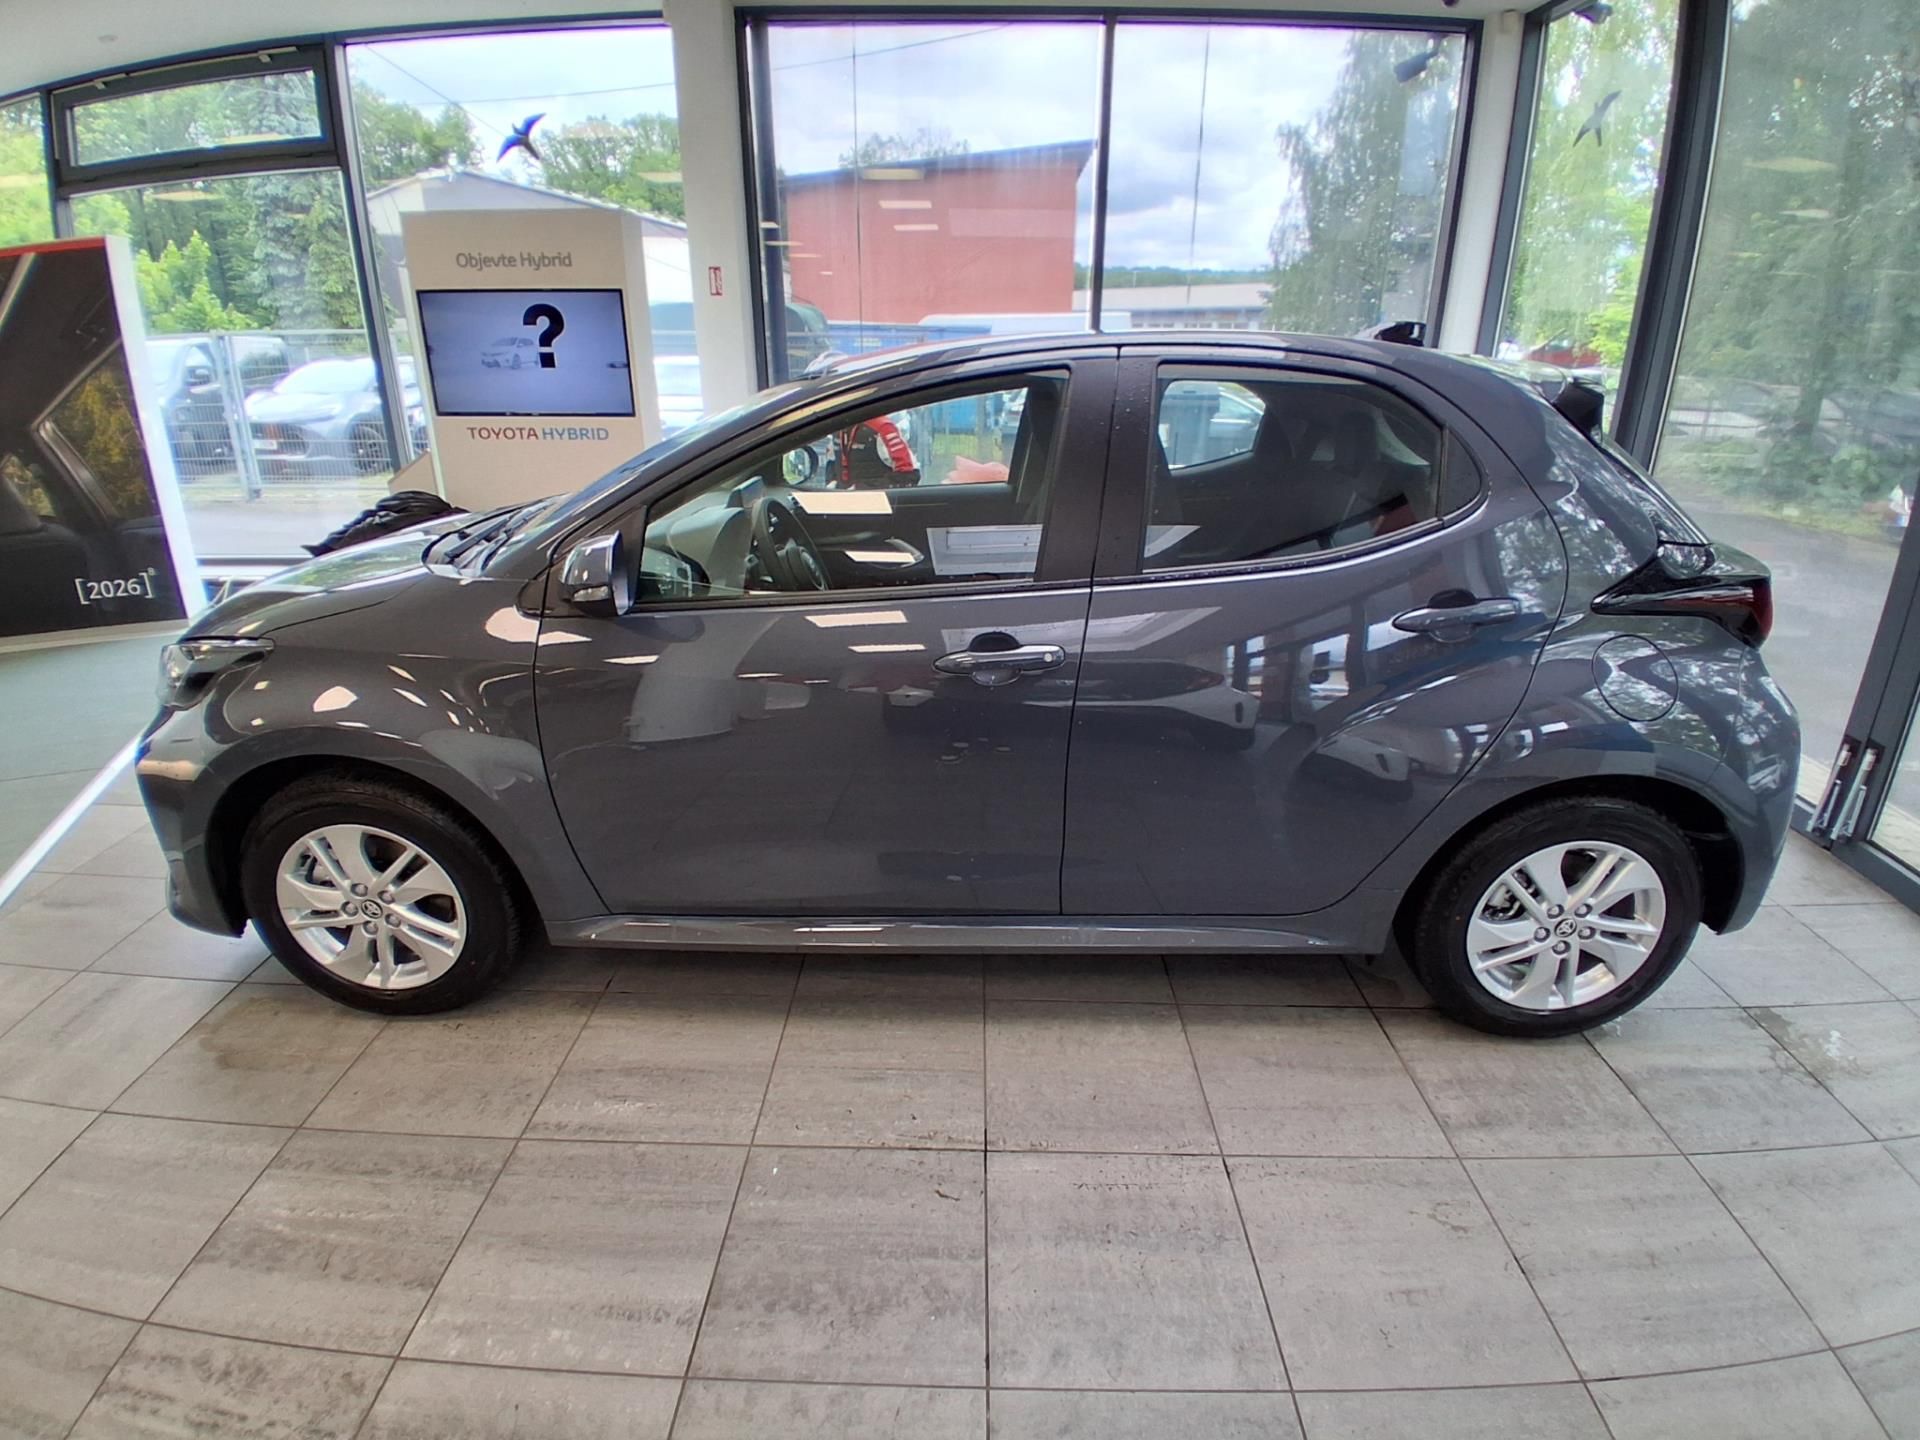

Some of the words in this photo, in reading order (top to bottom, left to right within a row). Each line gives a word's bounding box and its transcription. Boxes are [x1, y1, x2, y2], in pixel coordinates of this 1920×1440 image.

[455, 252, 517, 271] Objevte
[520, 252, 573, 271] Hybrid
[523, 303, 565, 368] ?
[467, 427, 539, 440] TOYOTA
[542, 427, 609, 440] HYBRID
